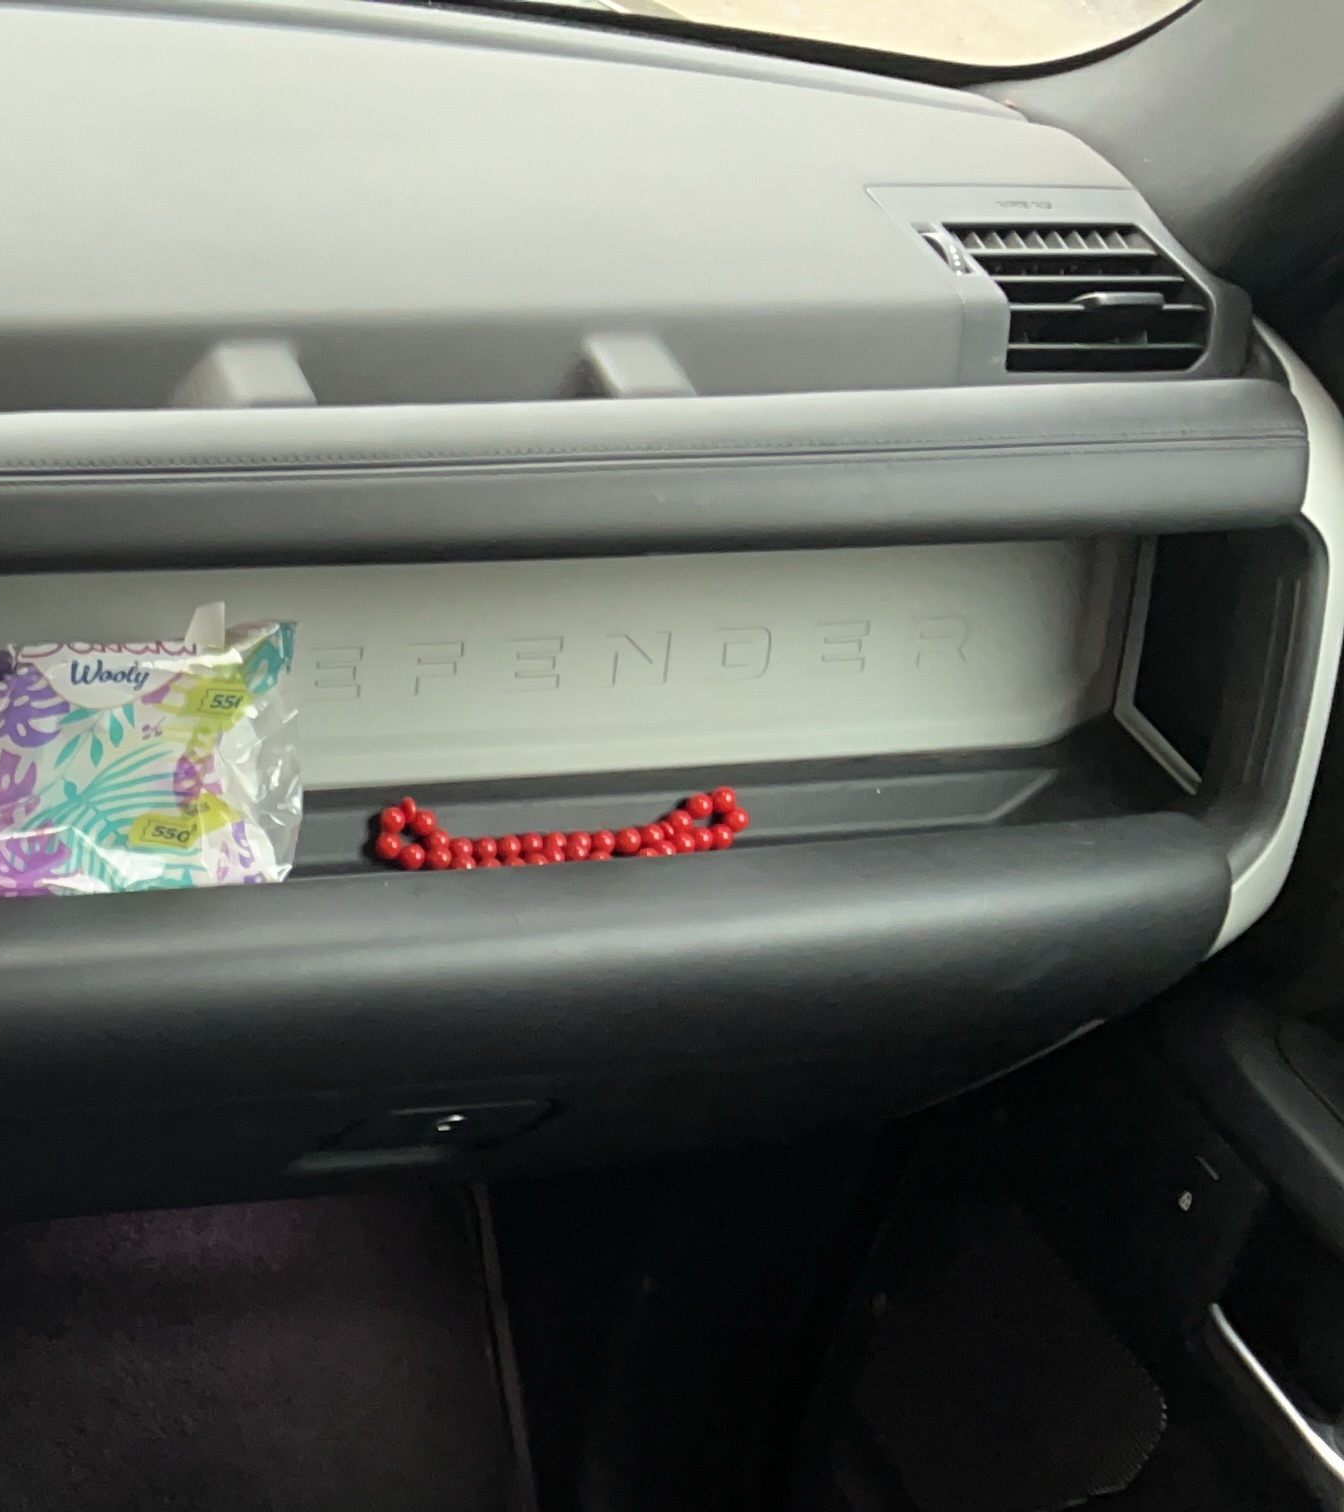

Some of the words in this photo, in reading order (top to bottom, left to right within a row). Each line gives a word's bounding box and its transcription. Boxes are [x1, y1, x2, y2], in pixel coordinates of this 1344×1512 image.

[70, 657, 150, 691] Wooly
[308, 616, 970, 702] EFENDER
[151, 825, 190, 843] 550
